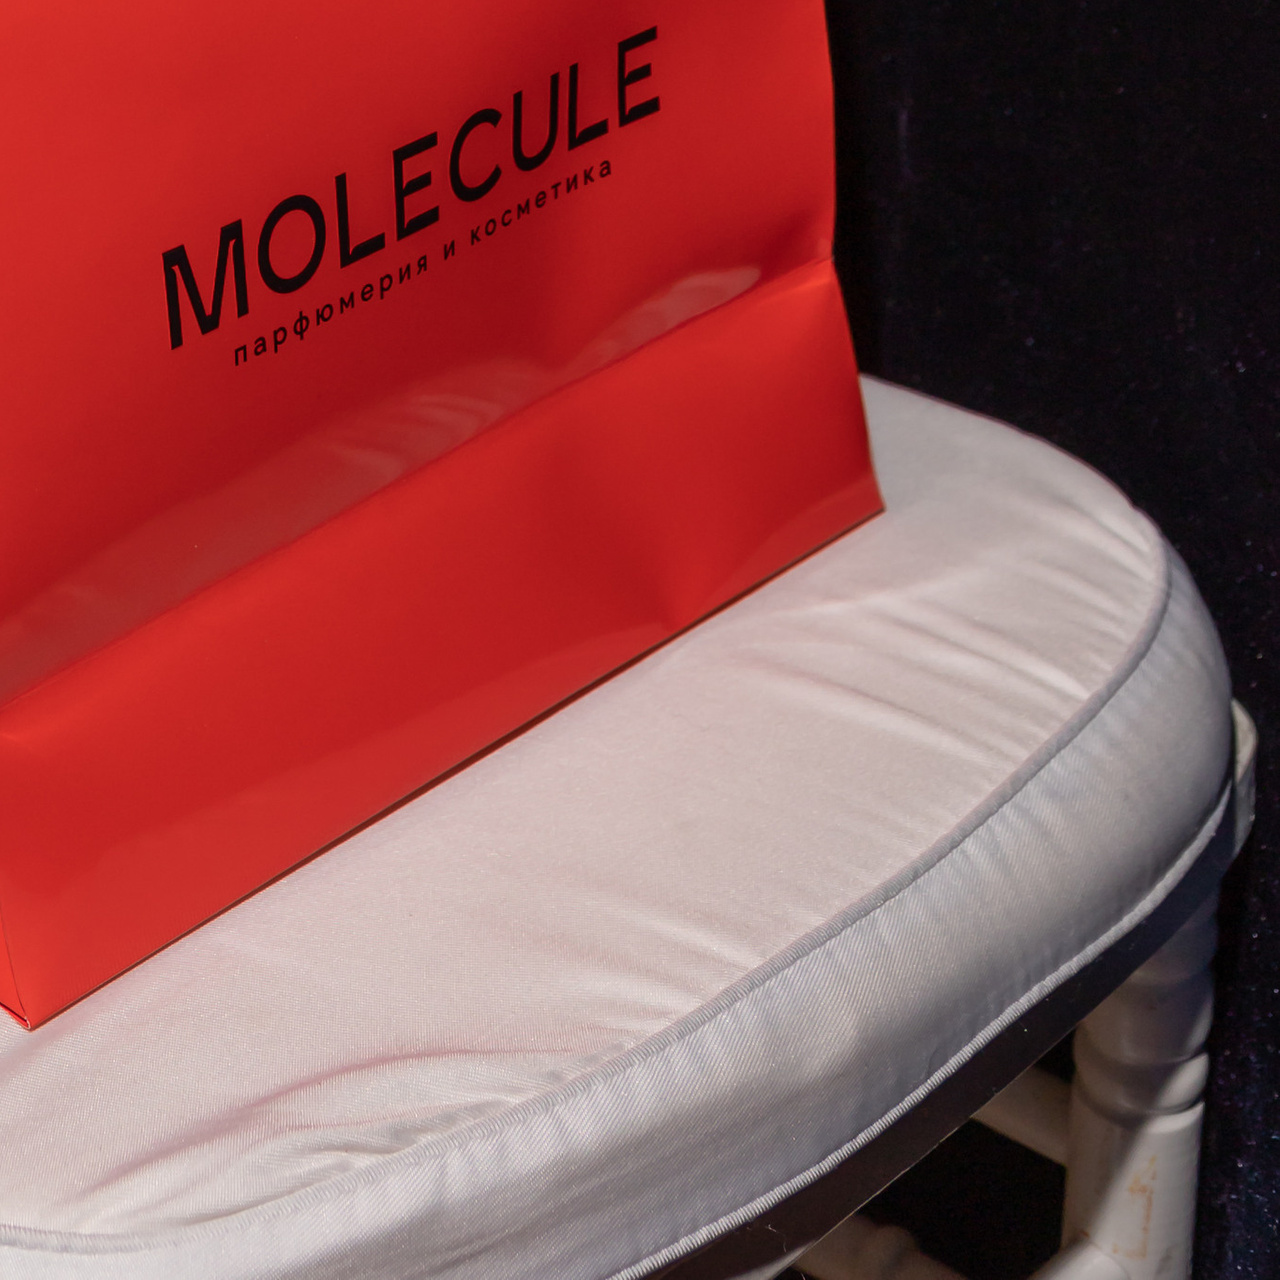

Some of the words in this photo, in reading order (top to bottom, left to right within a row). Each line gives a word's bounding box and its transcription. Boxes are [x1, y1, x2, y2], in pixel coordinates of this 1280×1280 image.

[161, 25, 661, 351] MOLECULE
[233, 254, 428, 367] парфюмерия
[442, 239, 456, 261] и
[470, 160, 612, 246] косметика
